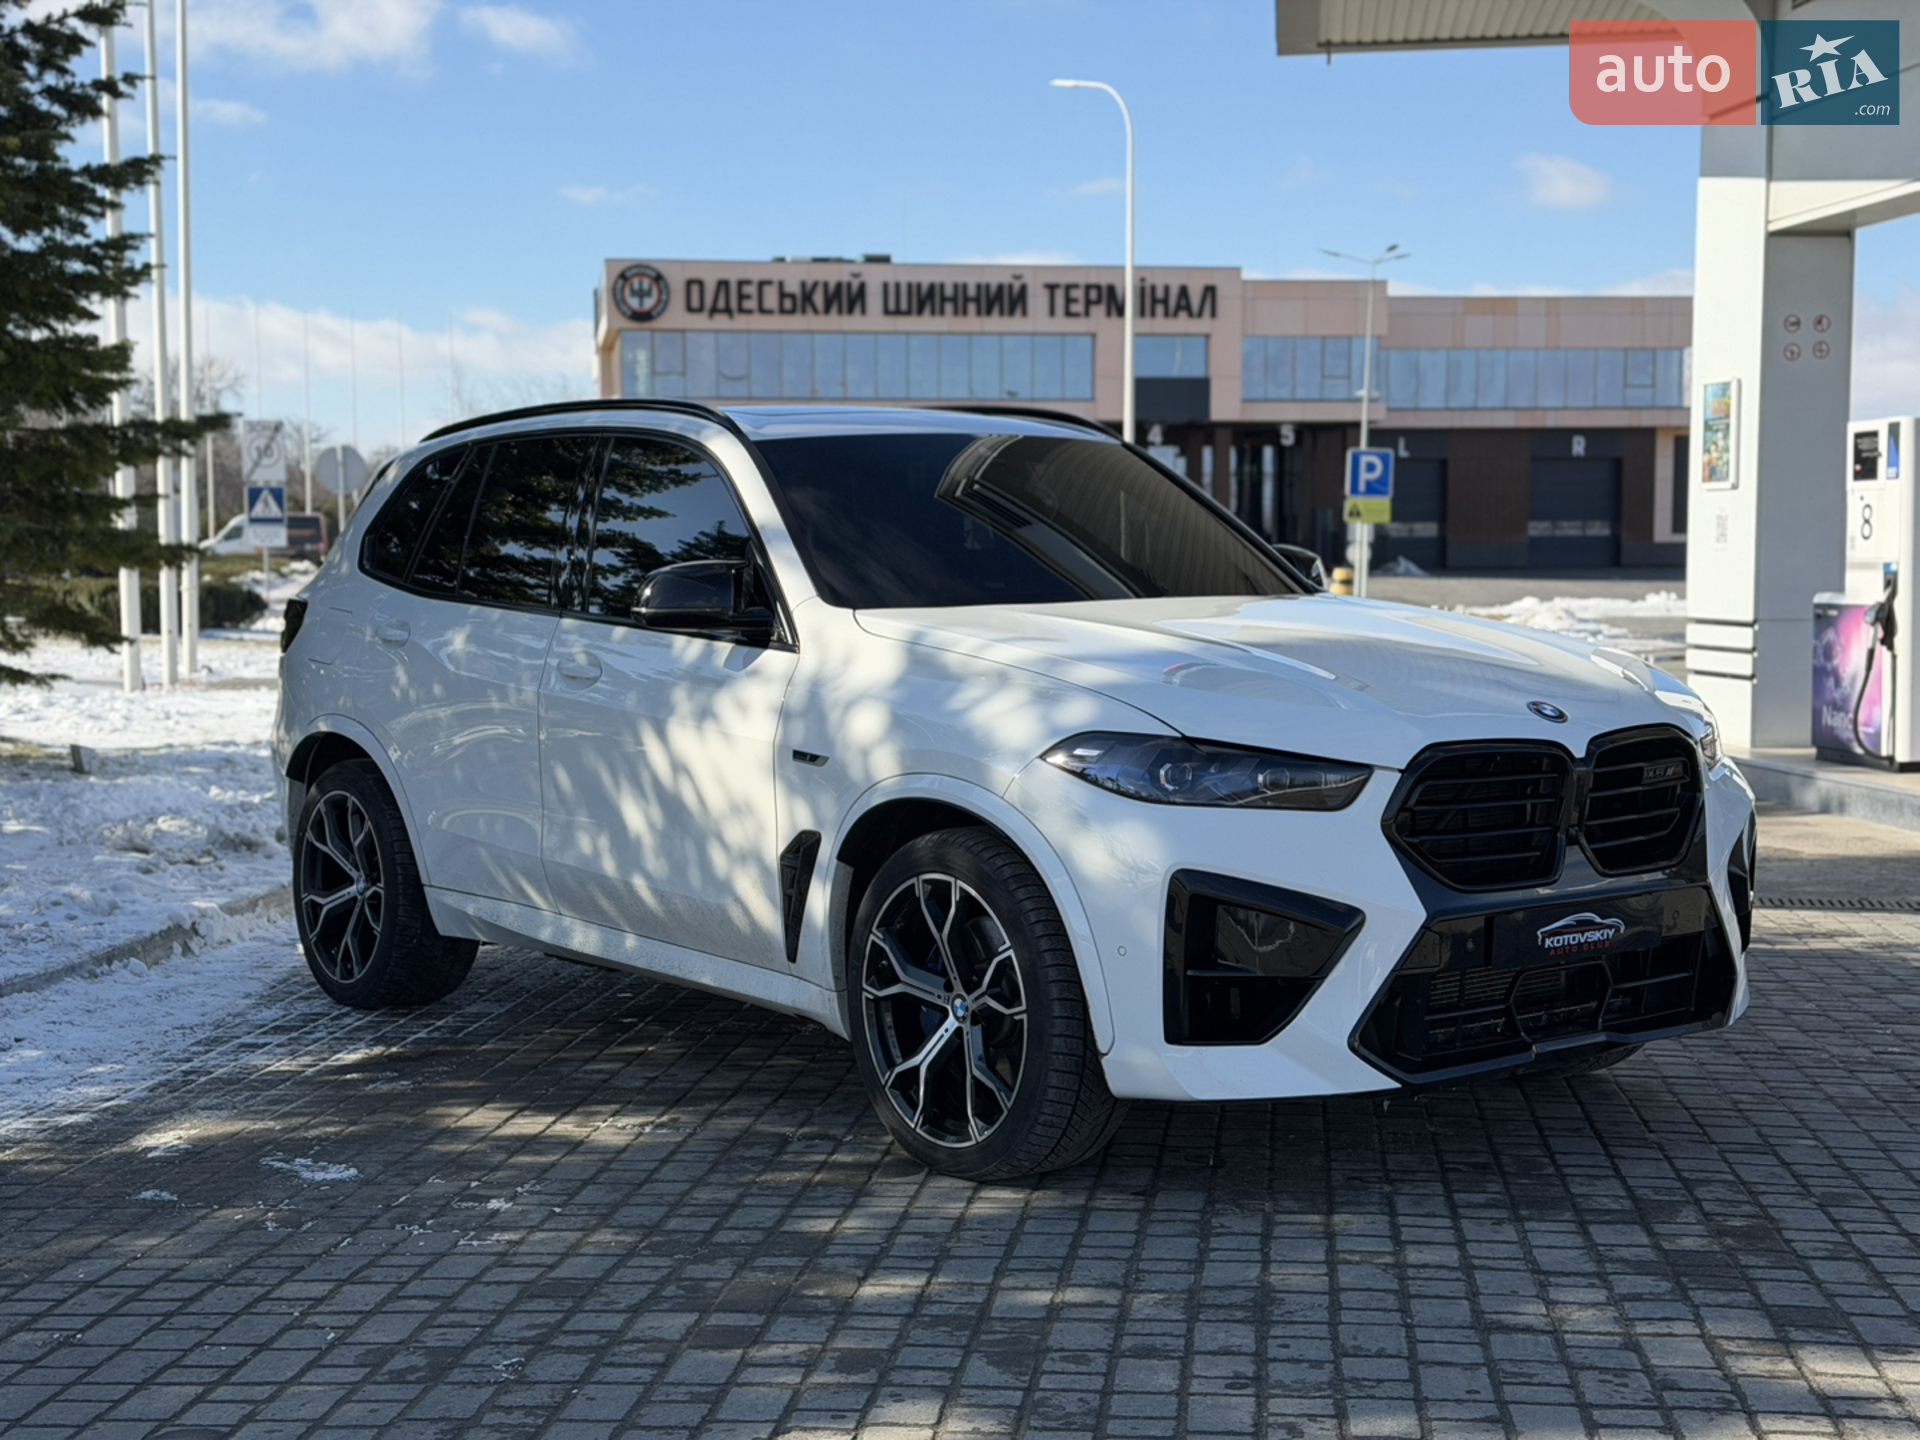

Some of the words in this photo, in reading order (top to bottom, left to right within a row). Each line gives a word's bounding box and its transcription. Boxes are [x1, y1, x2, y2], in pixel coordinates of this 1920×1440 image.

[685, 272, 866, 320] ОДЕСЬКИЙ
[883, 273, 1028, 317] ШИННИЙ
[1146, 424, 1164, 446] 4
[1279, 423, 1296, 447] 5
[1397, 436, 1411, 458] L
[1571, 434, 1586, 458] R
[1358, 454, 1384, 494] P
[1861, 503, 1873, 541] 8
[1544, 928, 1616, 949] KOTOVSKIY
[1549, 946, 1578, 957] AUTO
[1583, 941, 1611, 950] CLUB
